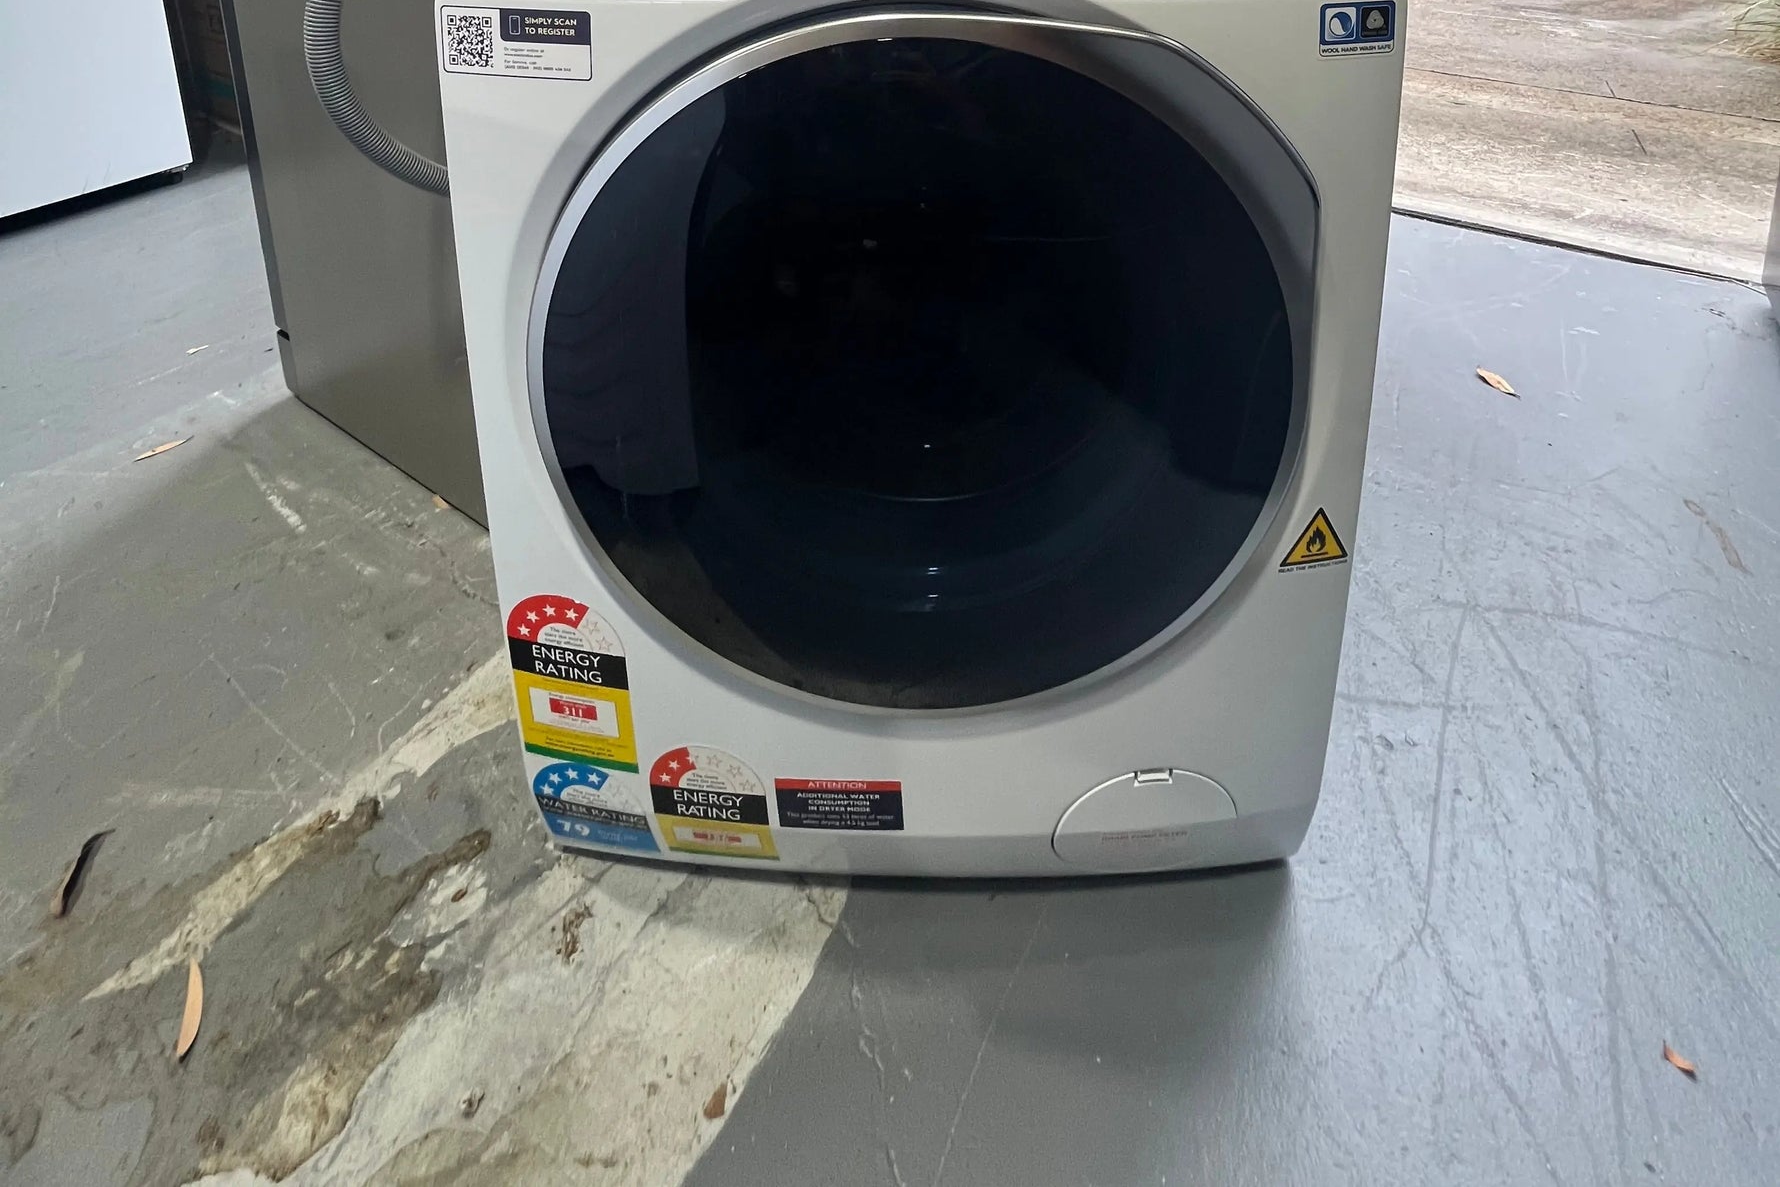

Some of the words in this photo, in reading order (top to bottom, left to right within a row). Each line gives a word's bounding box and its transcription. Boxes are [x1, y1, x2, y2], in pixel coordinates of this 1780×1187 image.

[524, 16, 552, 26] SIMPLY
[554, 18, 577, 26] SCAN
[524, 27, 536, 35] TO
[538, 28, 576, 36] REGISTER
[532, 645, 601, 668] ENERGY
[535, 661, 602, 684] RATING
[563, 706, 583, 718] 311
[807, 781, 867, 789] ATTENTION
[673, 789, 744, 807] ENERGY
[538, 796, 589, 814] WATER
[591, 808, 646, 825] RATING
[677, 803, 741, 821] RATING
